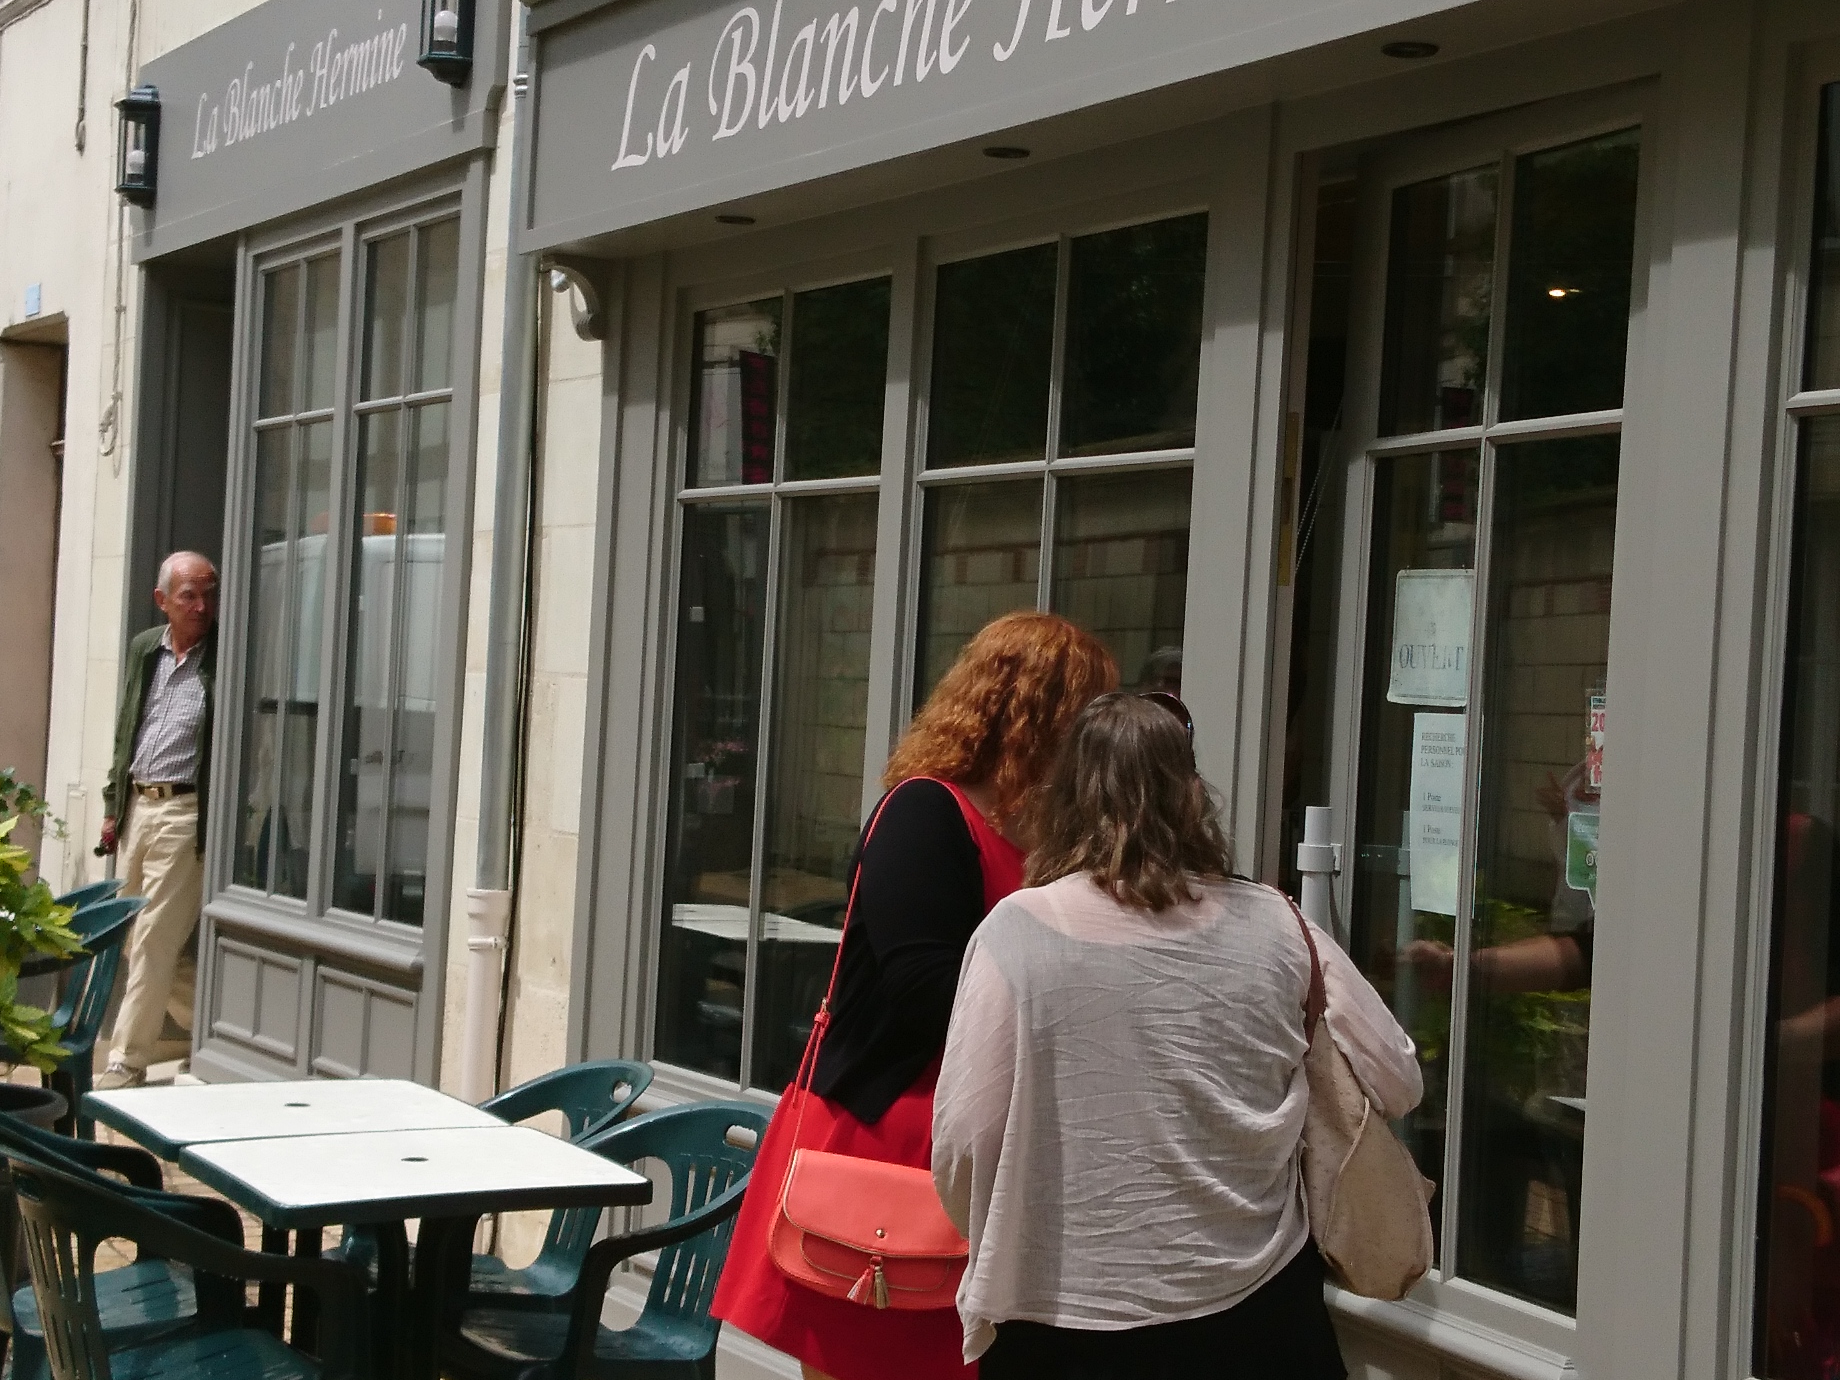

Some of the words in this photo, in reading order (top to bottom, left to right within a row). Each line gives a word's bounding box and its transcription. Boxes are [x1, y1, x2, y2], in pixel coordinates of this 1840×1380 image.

[191, 92, 218, 161] La
[223, 41, 305, 147] Blanche
[306, 7, 408, 118] Hermine
[610, 43, 691, 172] La
